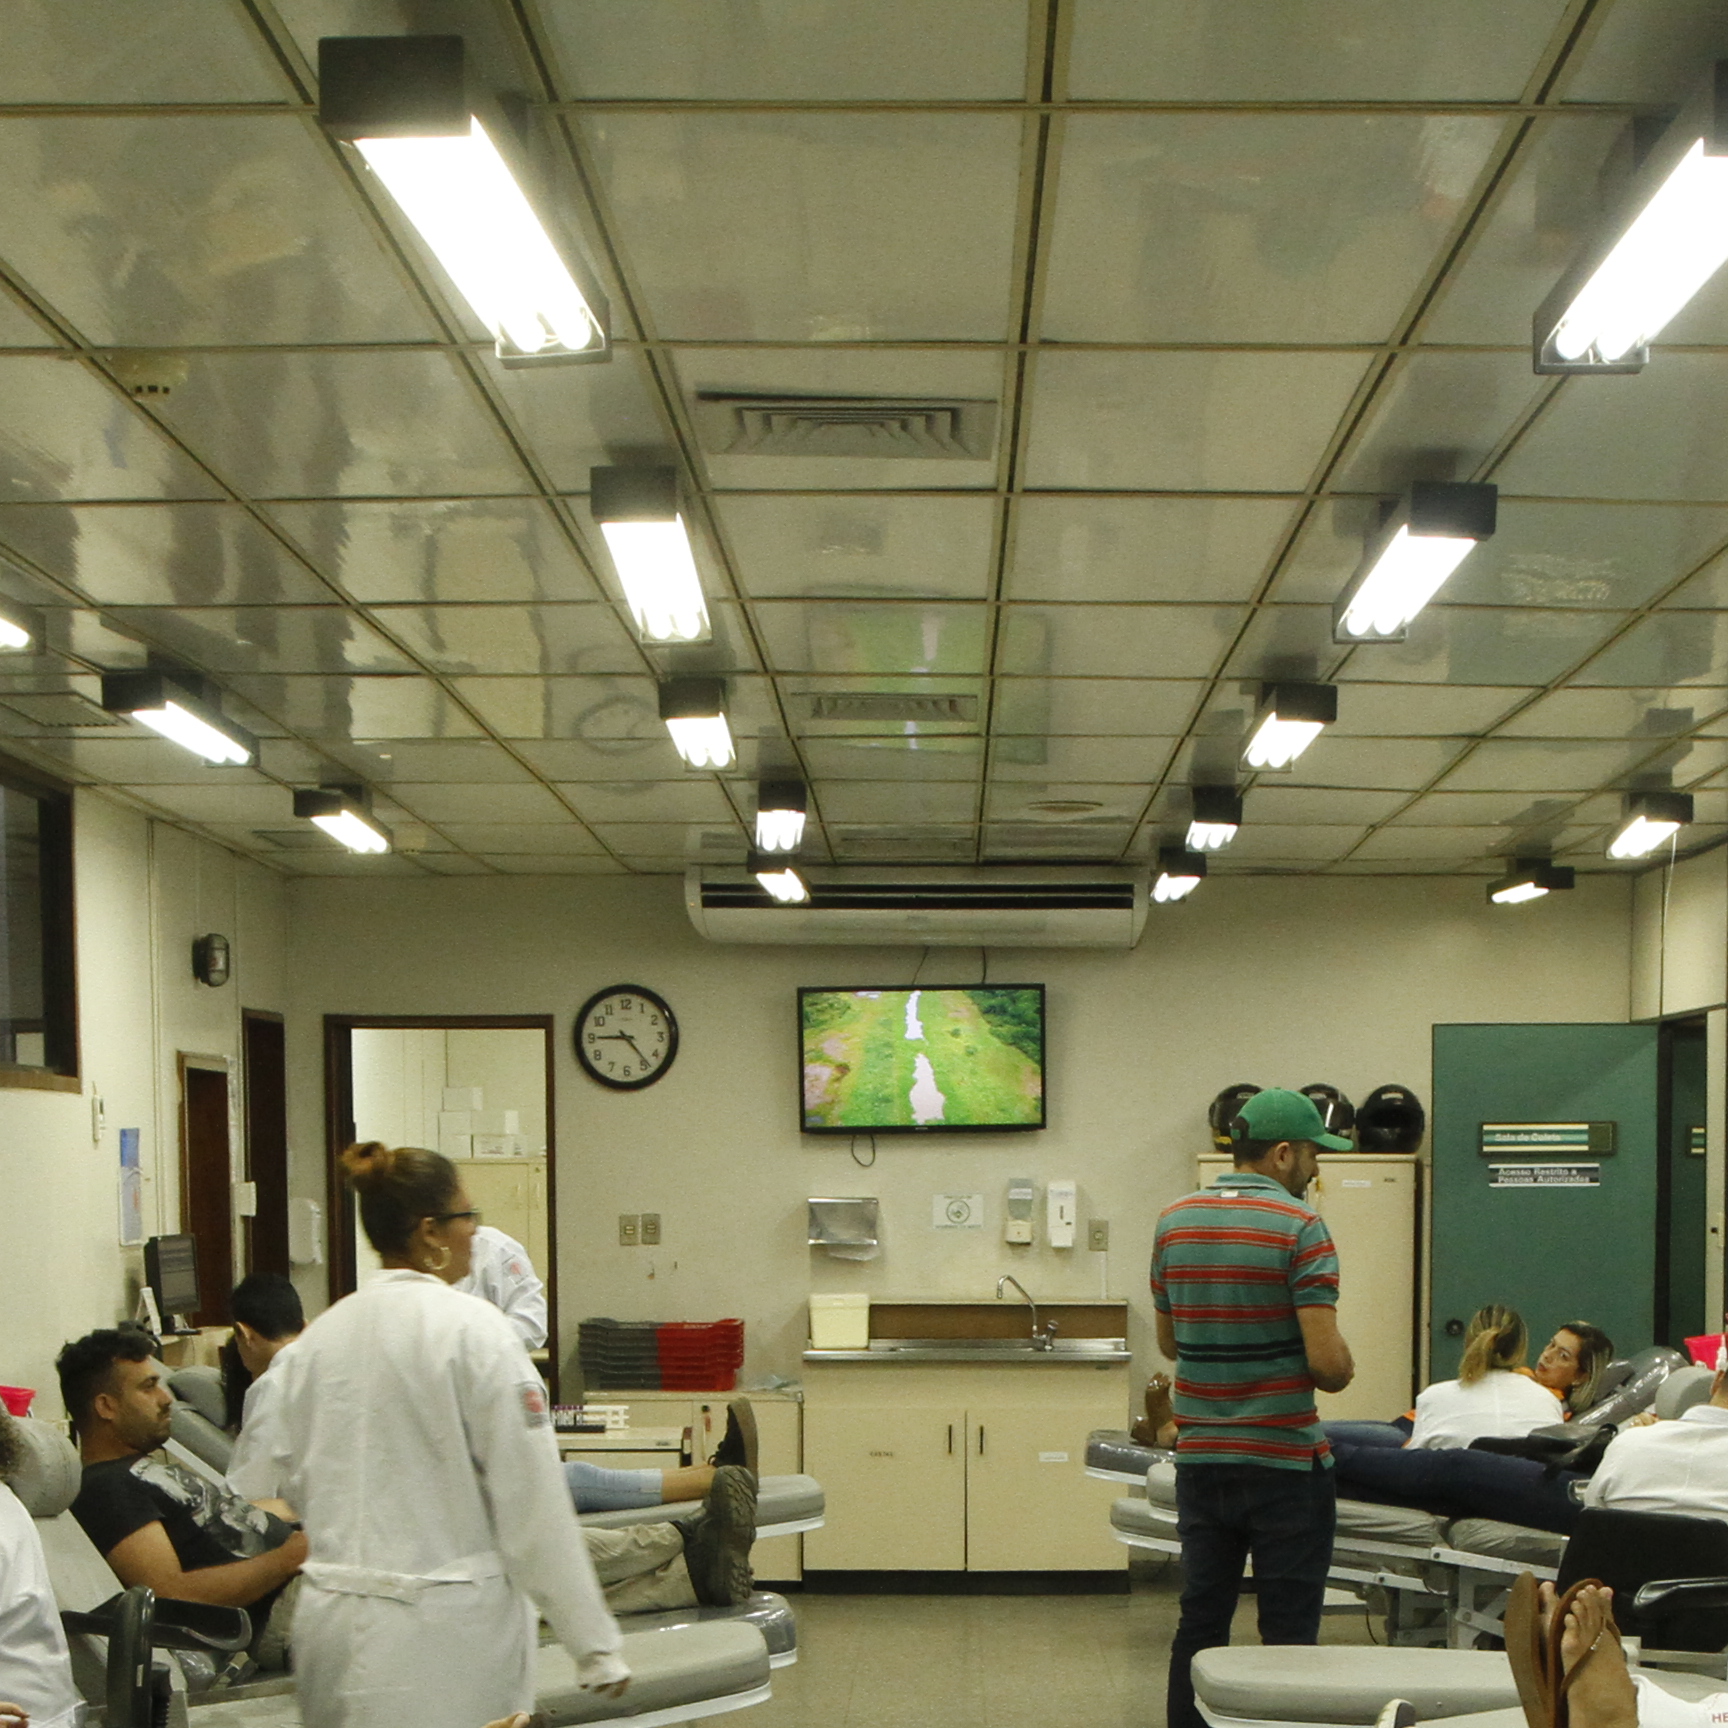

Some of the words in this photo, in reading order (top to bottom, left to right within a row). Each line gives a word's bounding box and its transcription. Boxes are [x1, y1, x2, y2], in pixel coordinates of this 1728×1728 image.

[605, 1004, 613, 1015] 11
[620, 999, 632, 1010] 12
[640, 1003, 645, 1014] 1
[594, 1016, 605, 1027] 10
[651, 1014, 658, 1026] 2
[588, 1033, 595, 1043] 9
[657, 1031, 664, 1042] 3
[594, 1050, 601, 1060] 8
[652, 1049, 659, 1058] 4
[608, 1061, 615, 1072] 7
[623, 1066, 631, 1076] 6
[639, 1060, 648, 1071] 5
